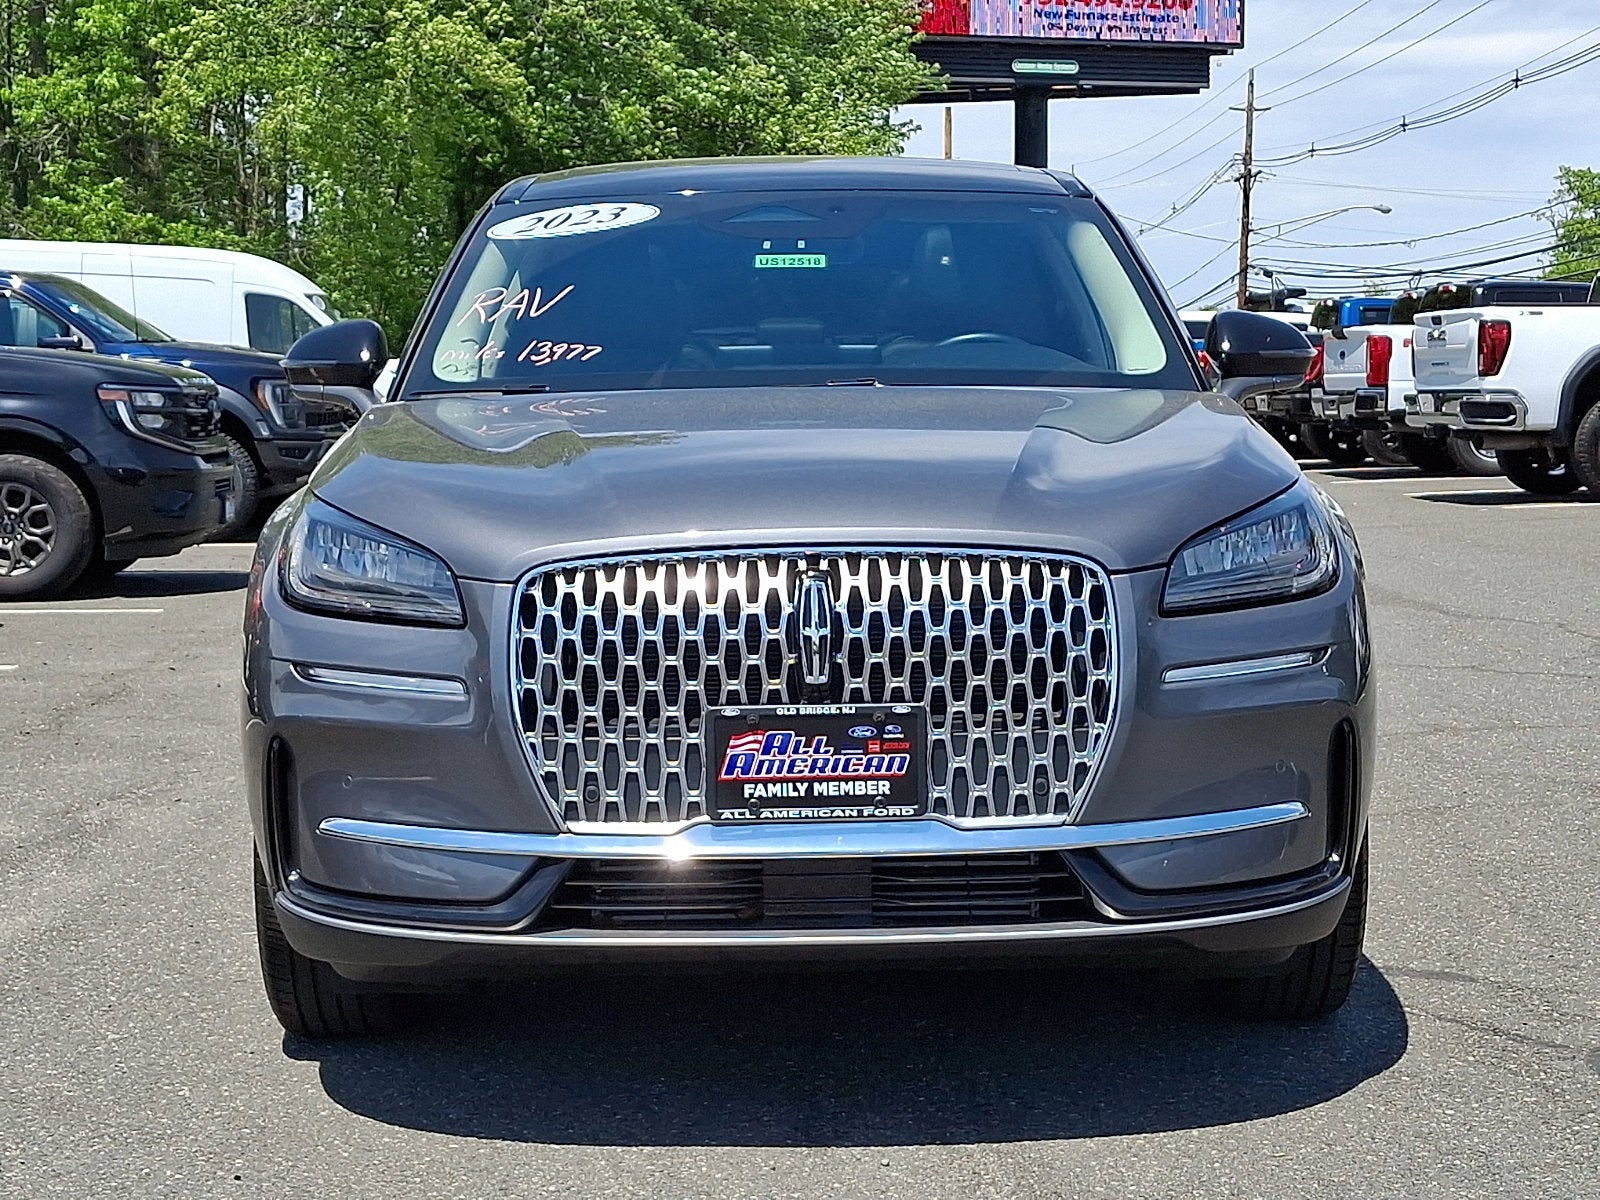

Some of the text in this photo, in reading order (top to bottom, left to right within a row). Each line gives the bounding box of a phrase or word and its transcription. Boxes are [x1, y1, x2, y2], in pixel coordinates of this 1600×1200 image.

[1033, 8, 1180, 23] New Furnace Estimate
[513, 206, 628, 235] 2023
[759, 257, 822, 266] US12518
[517, 339, 603, 366] 13977
[776, 707, 797, 716] OLD
[842, 706, 856, 714] NJ
[743, 780, 891, 799] FAMILY MEMBER
[720, 807, 915, 819] ALL AMERICAN FORD
